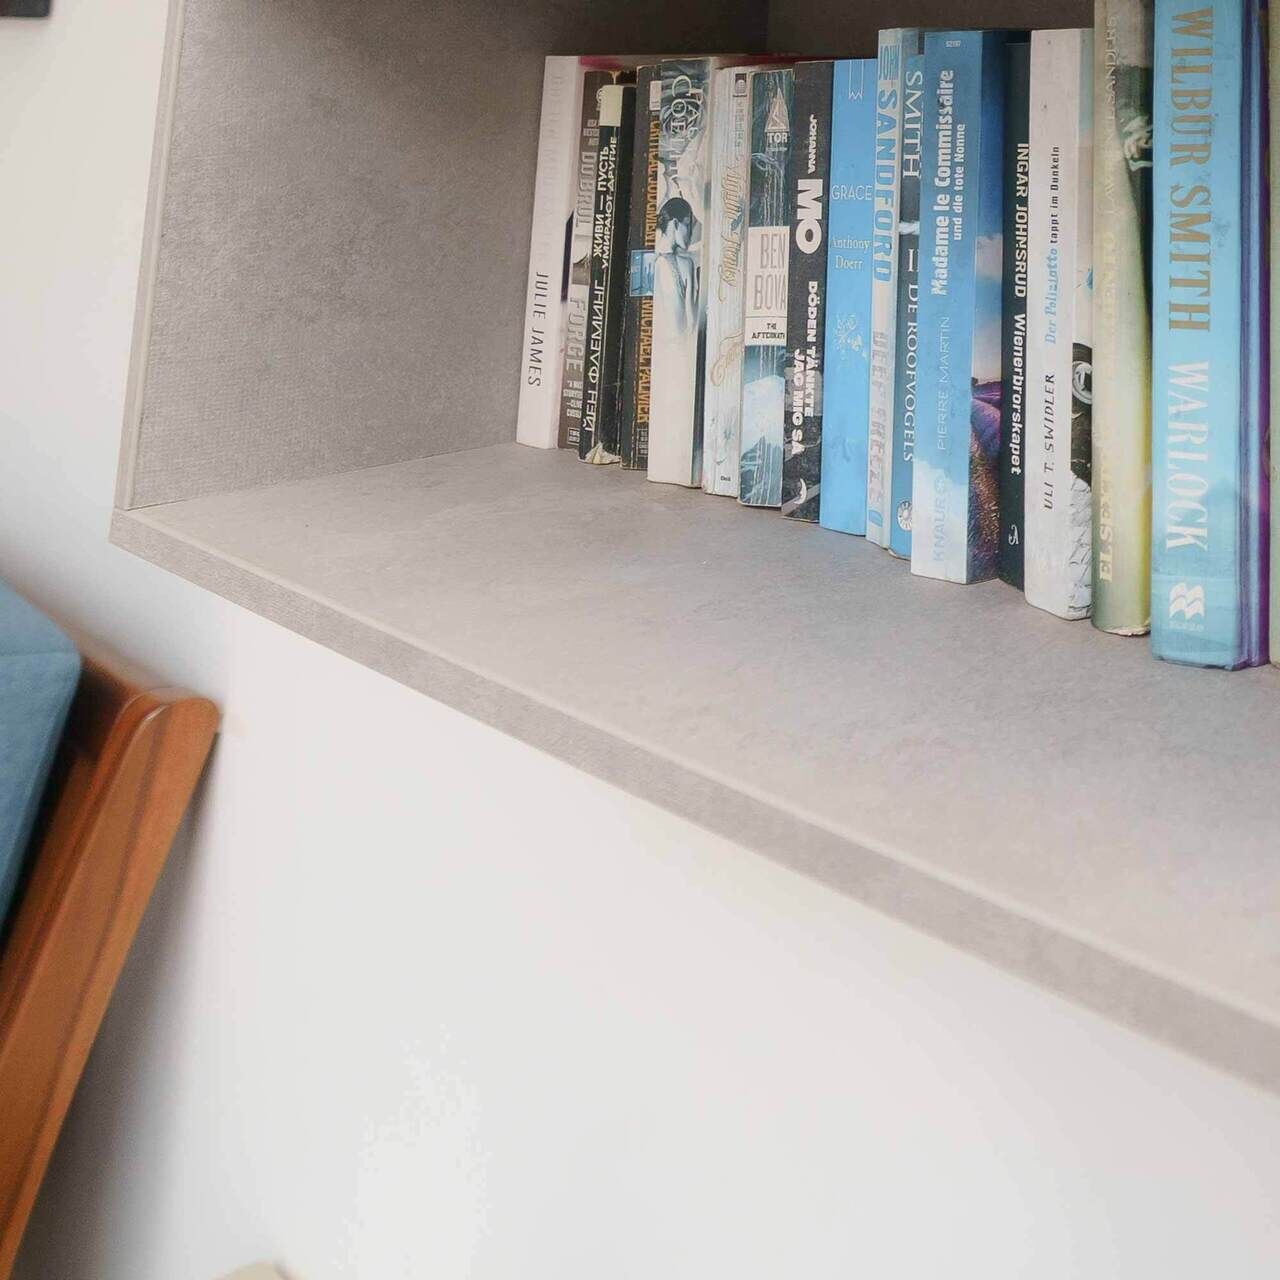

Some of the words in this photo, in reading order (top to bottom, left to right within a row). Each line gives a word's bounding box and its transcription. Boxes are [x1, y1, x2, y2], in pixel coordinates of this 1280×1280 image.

[1169, 7, 1215, 168] WILBUR
[765, 132, 790, 144] TOR
[806, 115, 818, 175] JOHANNA
[902, 69, 924, 180] SMITH
[934, 70, 954, 188] Commissaire
[954, 123, 966, 163] Nonne
[597, 146, 610, 191] ПУСТЬ
[606, 136, 618, 192] ДРУГИЕ
[872, 88, 898, 283] SANDFORD
[953, 165, 964, 192] tote
[1014, 142, 1030, 198] INGAR
[1050, 146, 1060, 191] Dunkeln
[645, 177, 658, 248] JUDGMENT
[794, 178, 823, 255] MO
[831, 185, 873, 201] GRACE
[933, 194, 950, 212] le
[953, 195, 963, 214] die
[1049, 196, 1060, 209] im
[592, 213, 606, 257] ЖИВИ
[601, 196, 616, 268] УМИРАЮТ
[760, 233, 787, 269] BEN
[930, 215, 950, 296] Madame
[953, 217, 963, 241] und
[1013, 203, 1029, 298] JOHNSRUD
[1047, 214, 1060, 244] tappt
[1167, 182, 1212, 337] SMITH
[531, 270, 549, 319] JULIE
[805, 281, 819, 343] DÖDEN
[906, 283, 919, 320] DE
[526, 327, 545, 388] JAMES
[586, 279, 609, 385] ФЛЕМИНГ
[938, 316, 951, 383] MARTIN
[793, 348, 807, 387] JAG
[803, 346, 818, 418] TÄNKTE
[791, 390, 805, 426] MIG
[936, 390, 949, 451] PIERRE
[1043, 373, 1056, 453] SWIDLER
[1043, 460, 1054, 474] T.
[1165, 361, 1211, 553] WARLOCK
[1043, 481, 1054, 511] ULI
